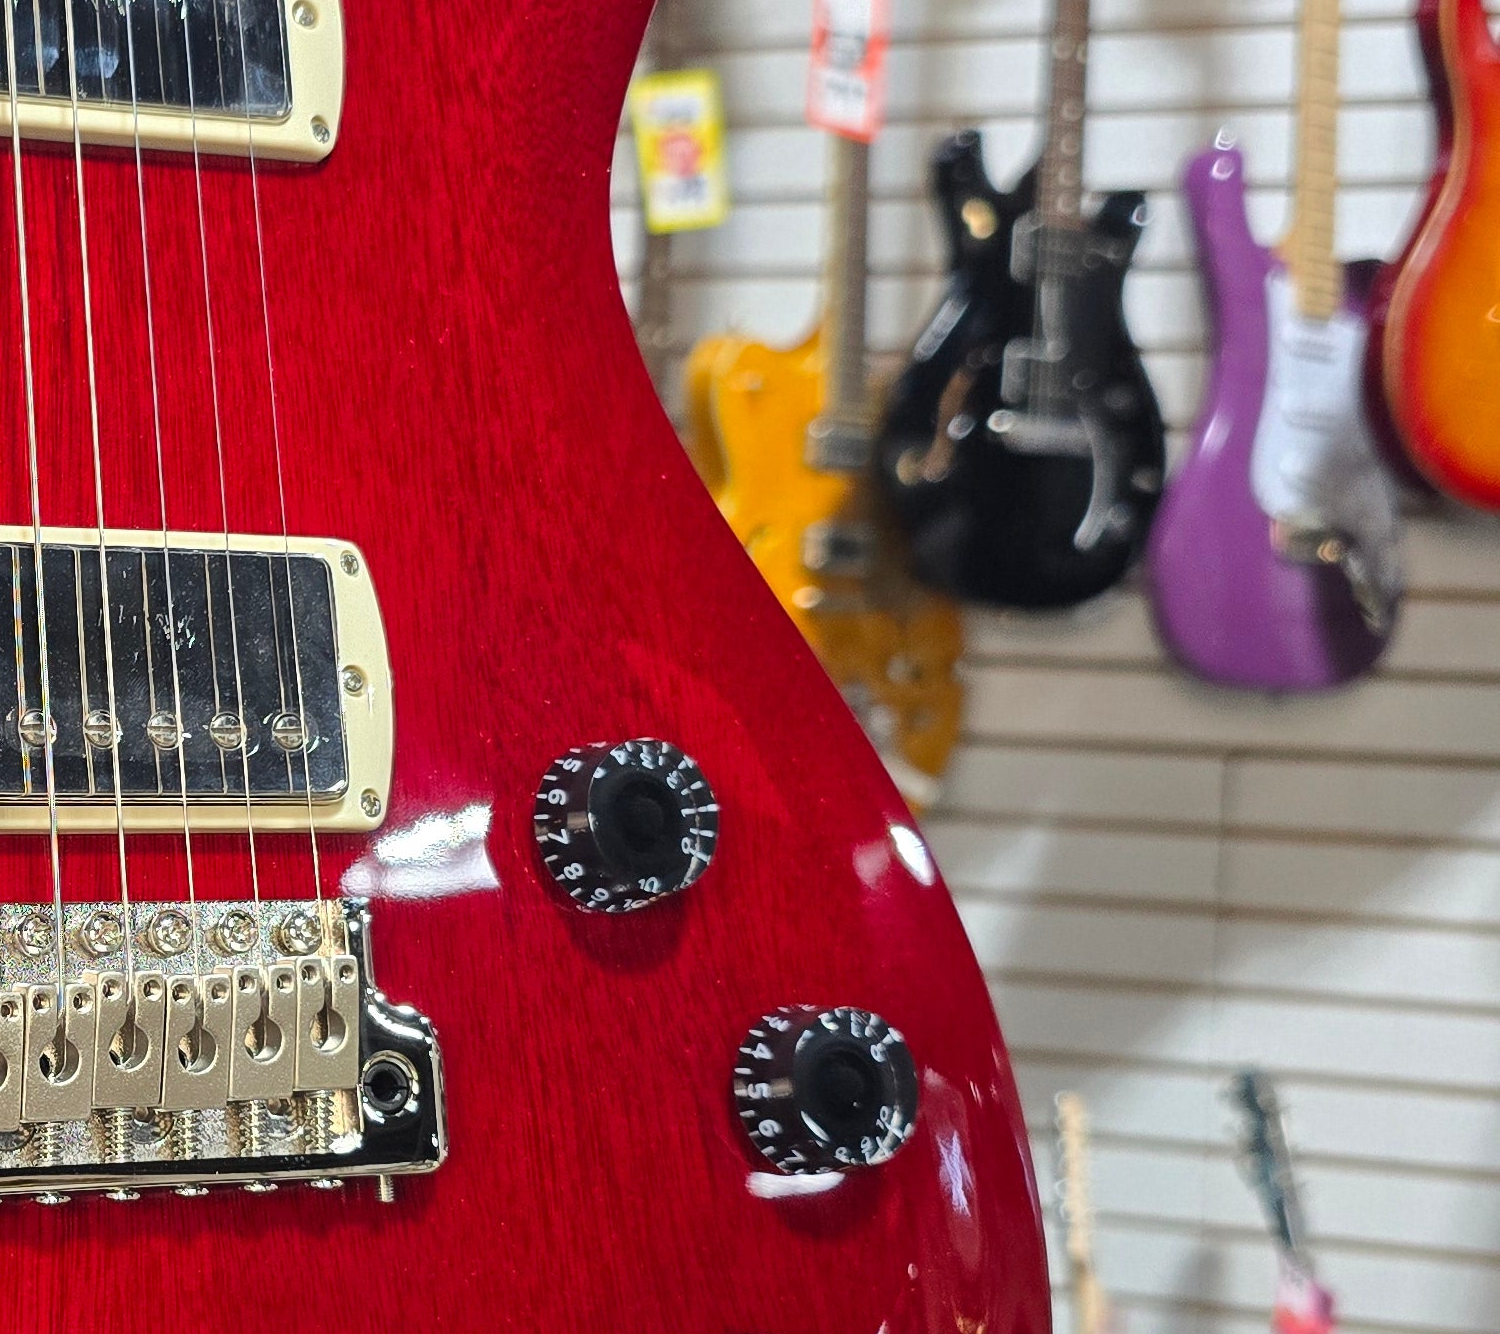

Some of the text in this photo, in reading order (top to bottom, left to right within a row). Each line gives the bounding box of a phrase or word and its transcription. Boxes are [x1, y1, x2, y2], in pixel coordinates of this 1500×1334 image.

[562, 757, 583, 773] 5
[547, 788, 568, 806] 6
[547, 828, 570, 845] 7
[563, 862, 584, 880] 8
[591, 887, 610, 902] 9
[752, 1042, 774, 1060] 4
[747, 1082, 772, 1100] 5
[758, 1118, 783, 1138] 6
